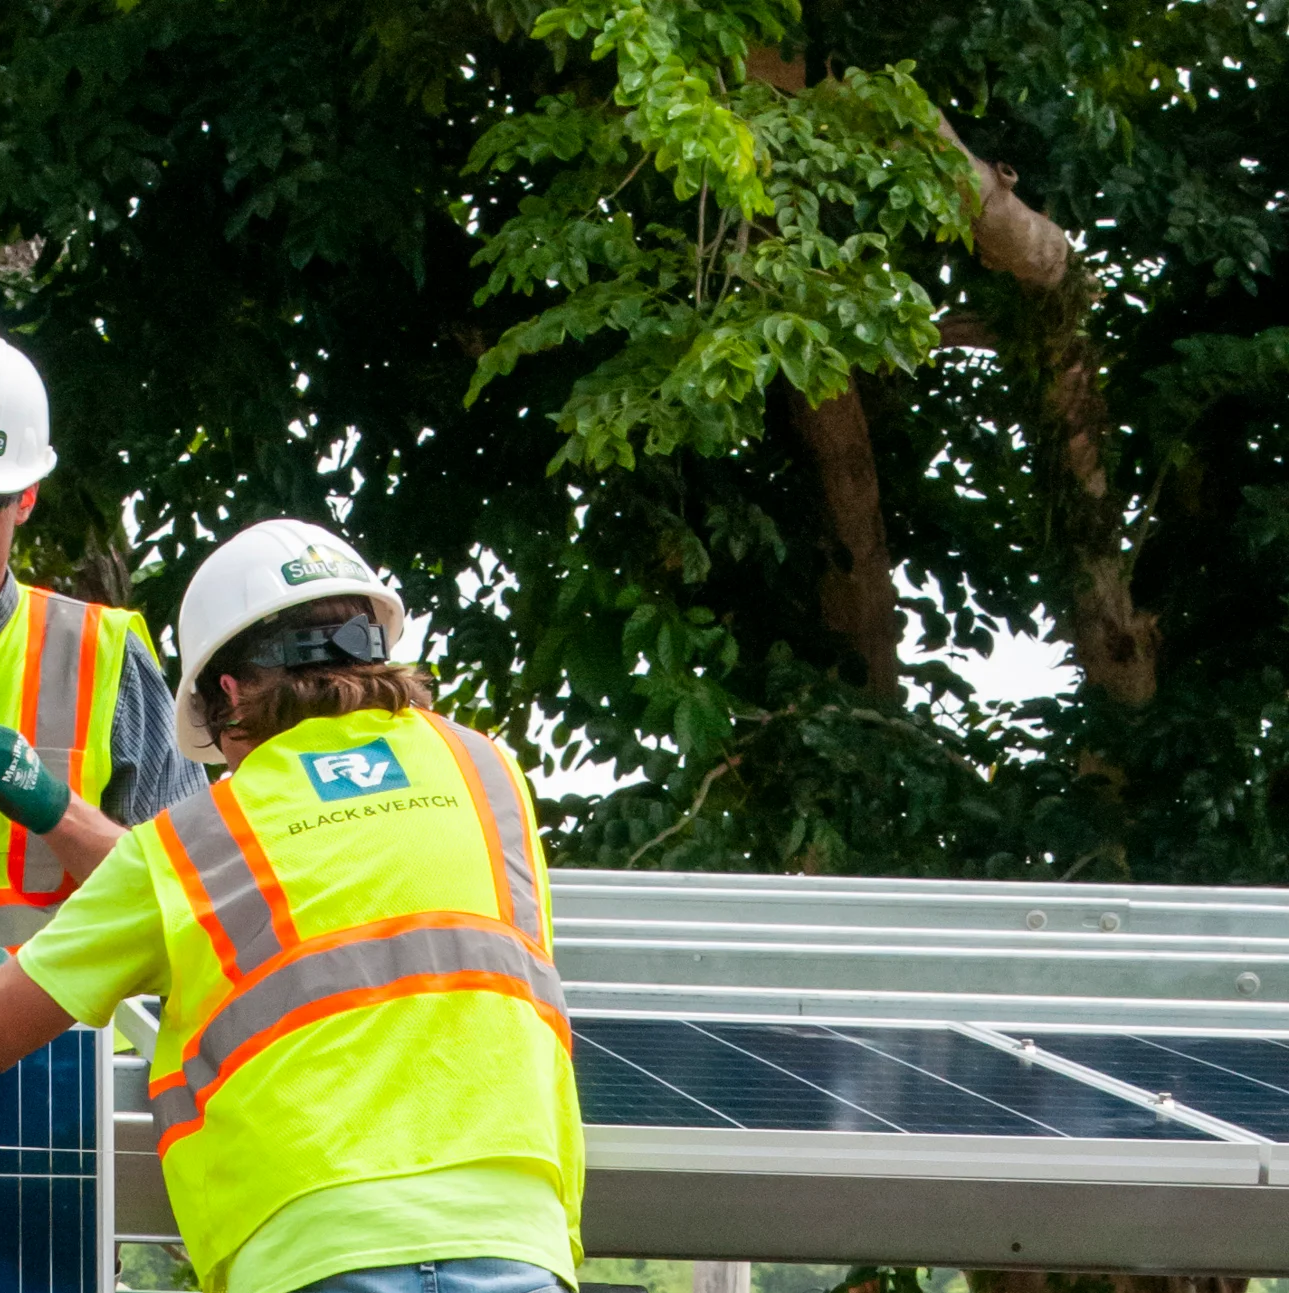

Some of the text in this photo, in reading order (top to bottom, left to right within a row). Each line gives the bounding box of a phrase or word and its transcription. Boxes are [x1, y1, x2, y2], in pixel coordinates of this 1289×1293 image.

[287, 795, 460, 836] BLACK & VEATCH
